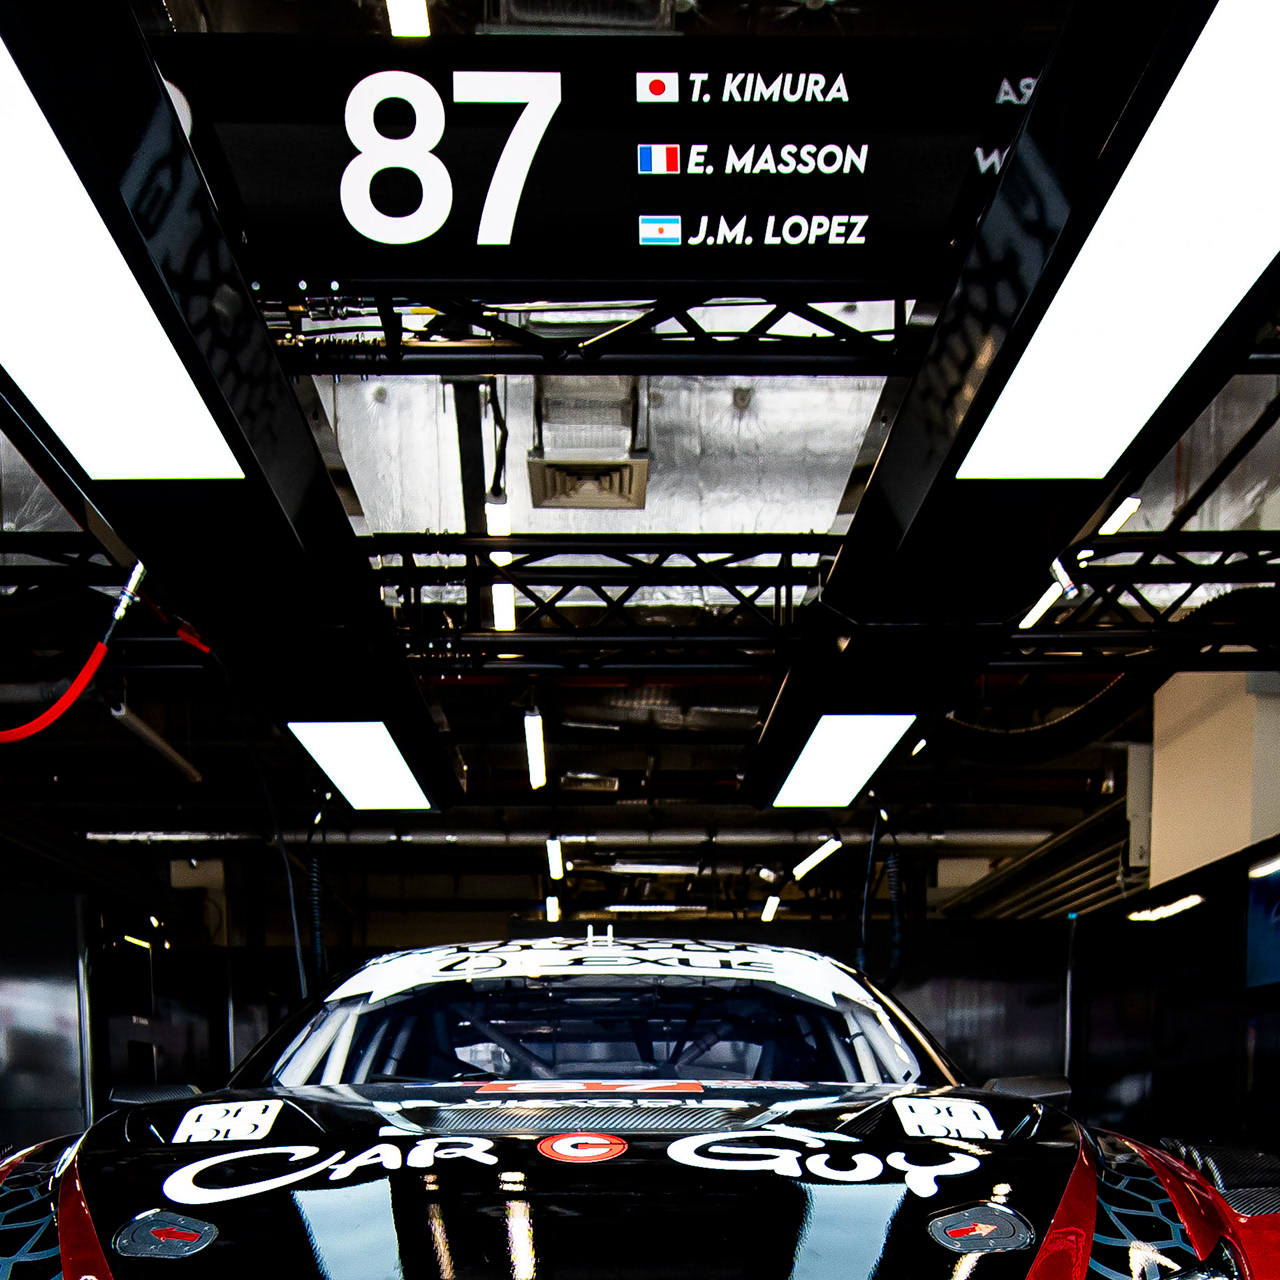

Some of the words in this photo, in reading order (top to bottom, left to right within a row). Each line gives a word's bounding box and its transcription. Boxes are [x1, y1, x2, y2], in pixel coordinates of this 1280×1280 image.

[689, 72, 711, 102] T.
[722, 72, 849, 102] KIMURA
[340, 70, 562, 246] 87
[687, 144, 714, 174] E.
[725, 144, 869, 174] MASSON
[687, 215, 753, 245] J.M.
[764, 215, 869, 244] LOPEZ
[162, 1136, 498, 1205] CAR
